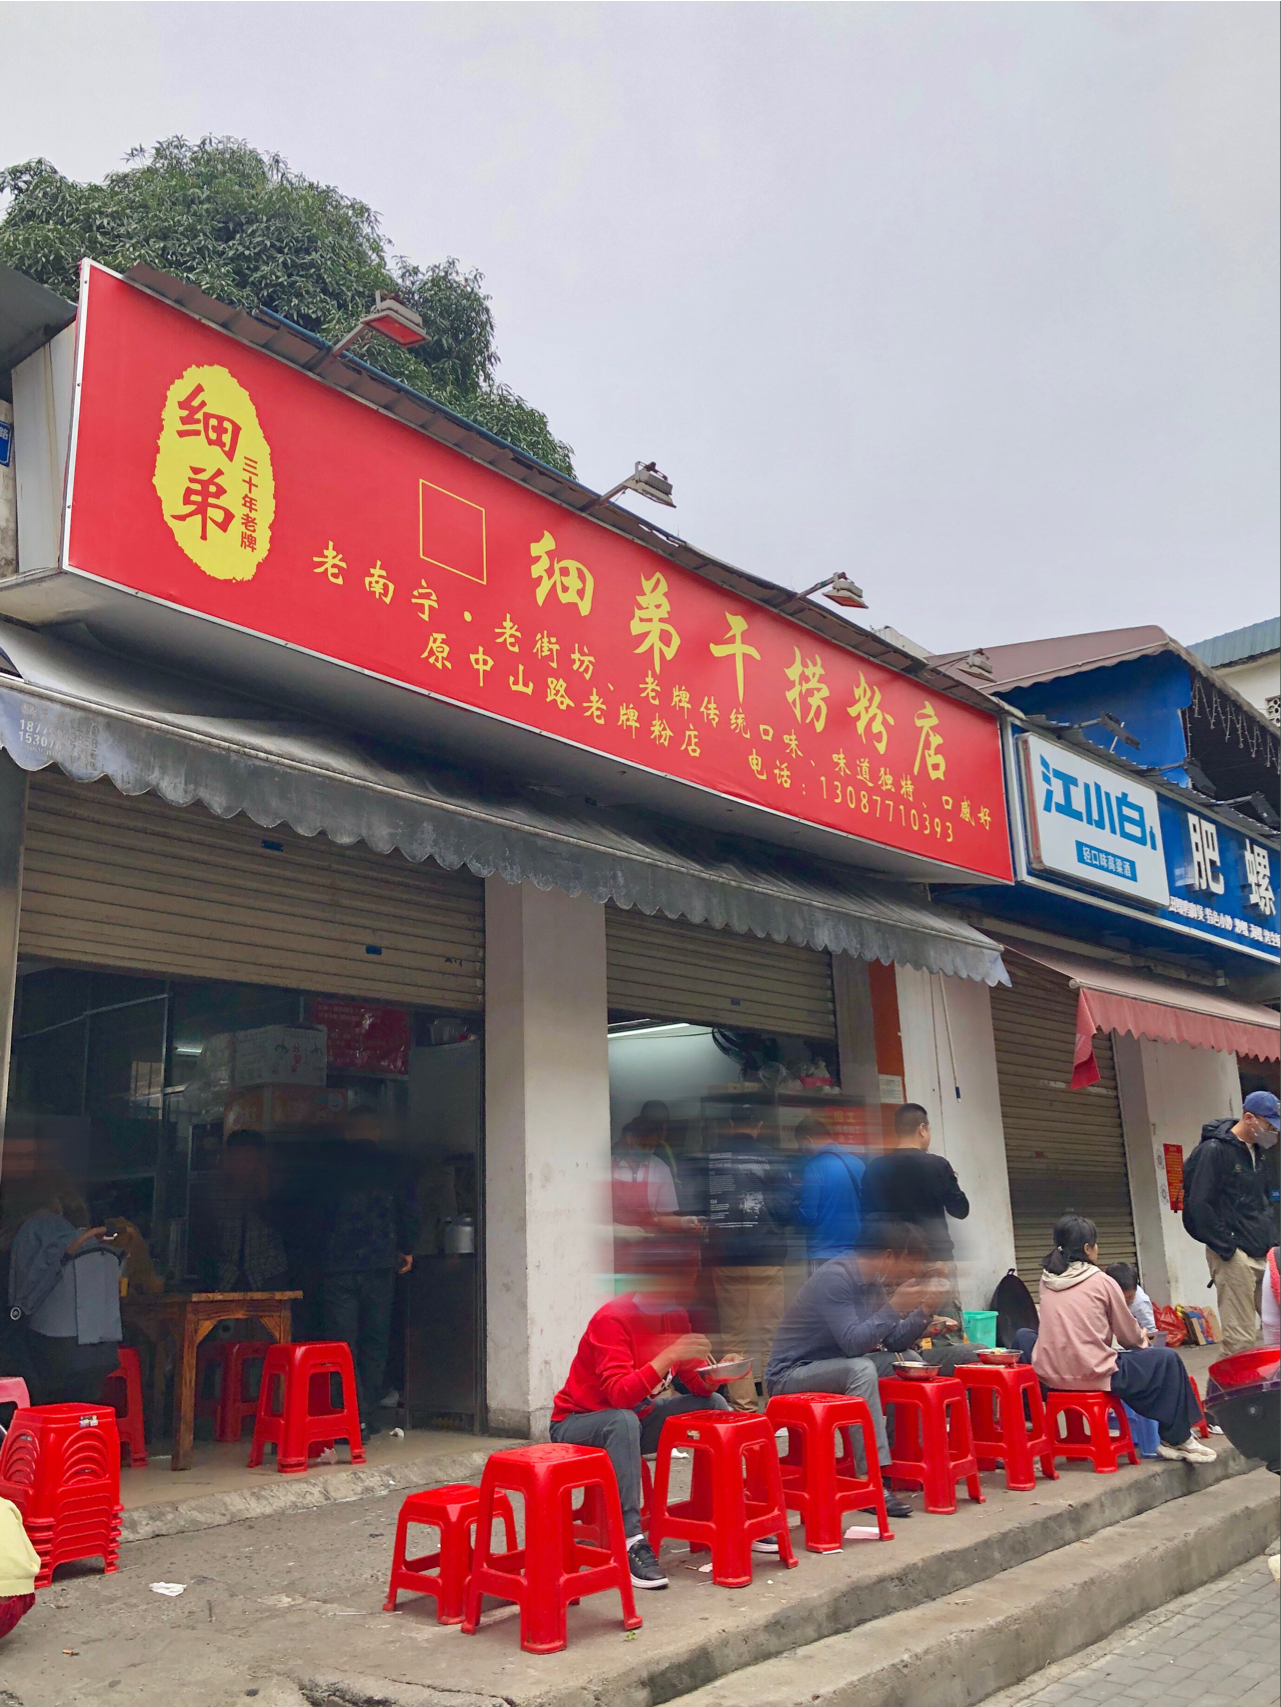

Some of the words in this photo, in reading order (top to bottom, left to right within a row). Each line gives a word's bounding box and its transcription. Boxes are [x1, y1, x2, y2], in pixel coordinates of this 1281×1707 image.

[168, 382, 243, 541] 细弟
[240, 456, 258, 553] 三十年老牌
[420, 632, 702, 759] 原中山路老牌粉店
[529, 530, 947, 782] 细弟干捞粉店
[1039, 754, 1149, 847] 江小白
[1082, 845, 1132, 878] 轻口味高粱酒
